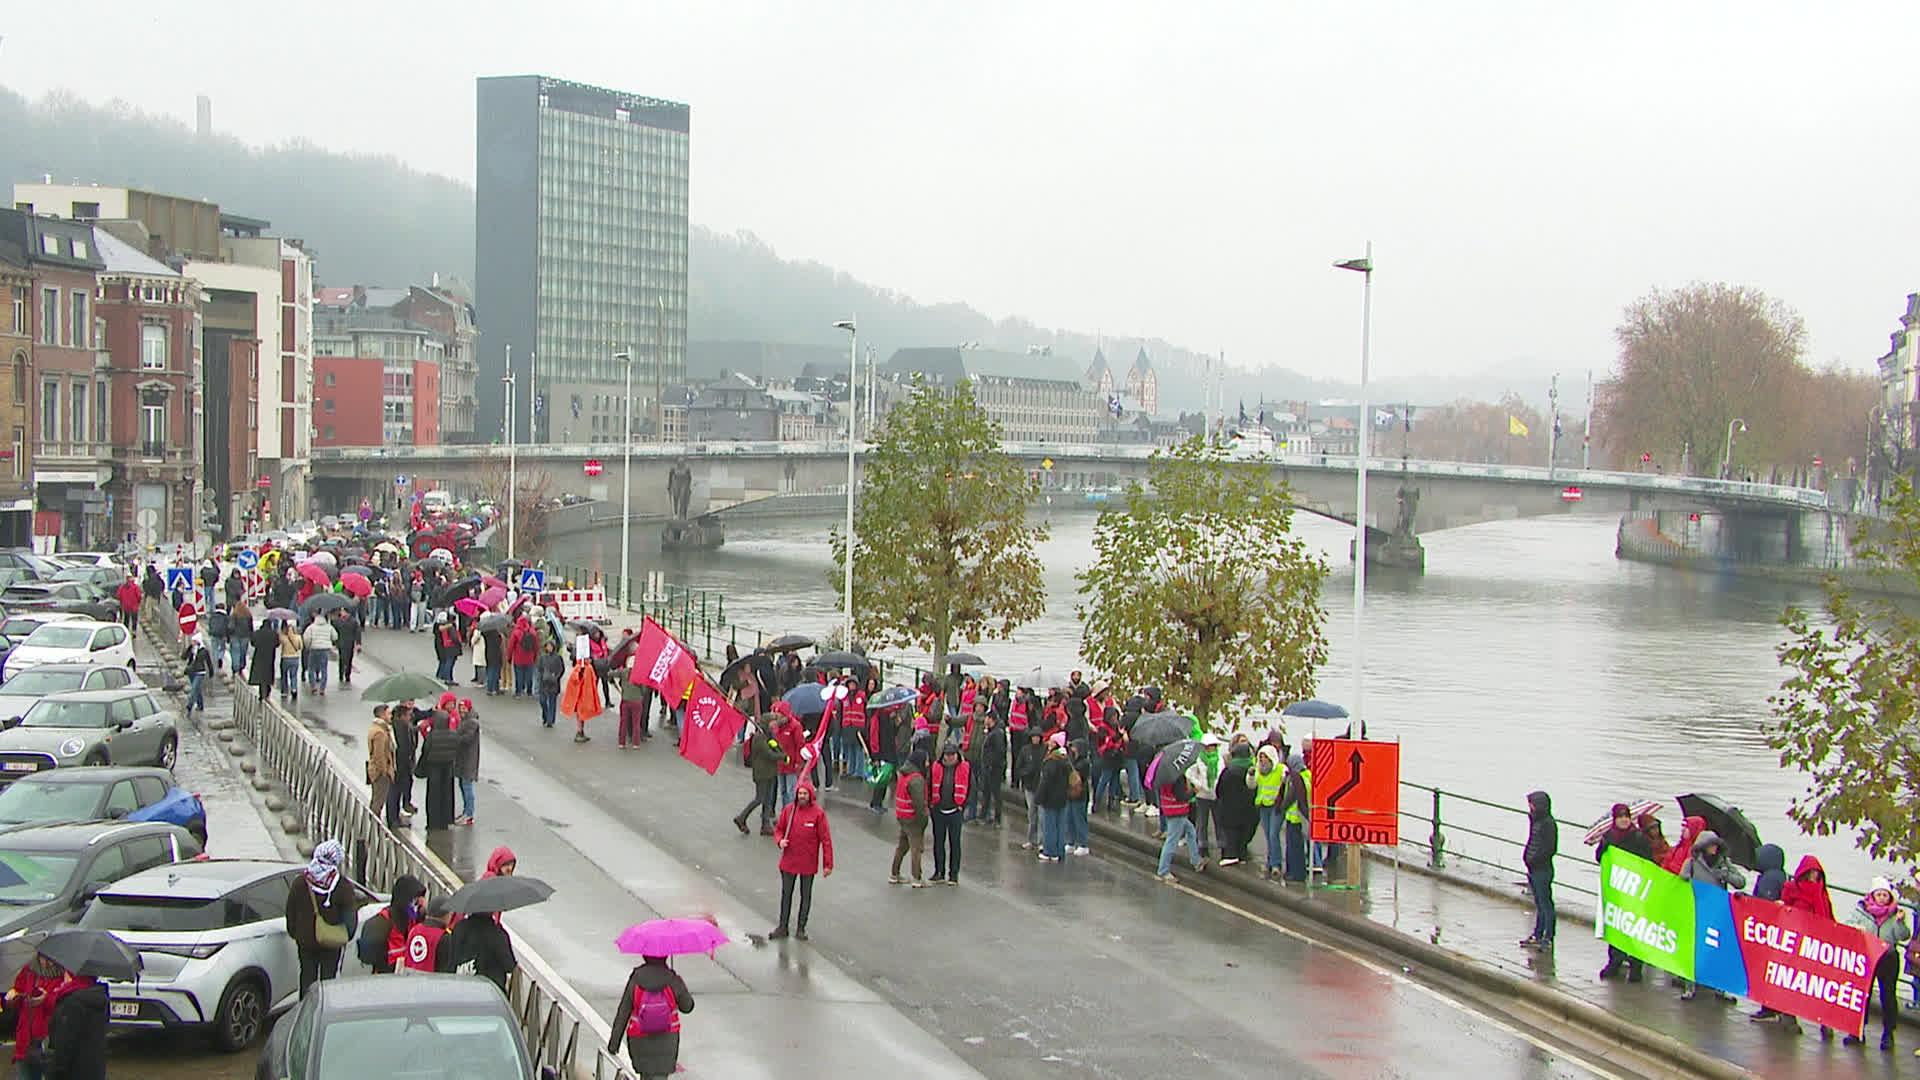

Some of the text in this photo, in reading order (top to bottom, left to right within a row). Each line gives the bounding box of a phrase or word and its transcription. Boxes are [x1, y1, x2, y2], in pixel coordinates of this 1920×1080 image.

[1324, 823, 1390, 844] 100m
[1609, 863, 1642, 897] MR
[1604, 901, 1678, 954] ENGAGÉS
[1743, 916, 1868, 977] ÉCOLE MOINS
[1765, 960, 1865, 1013] FINANCÉE
